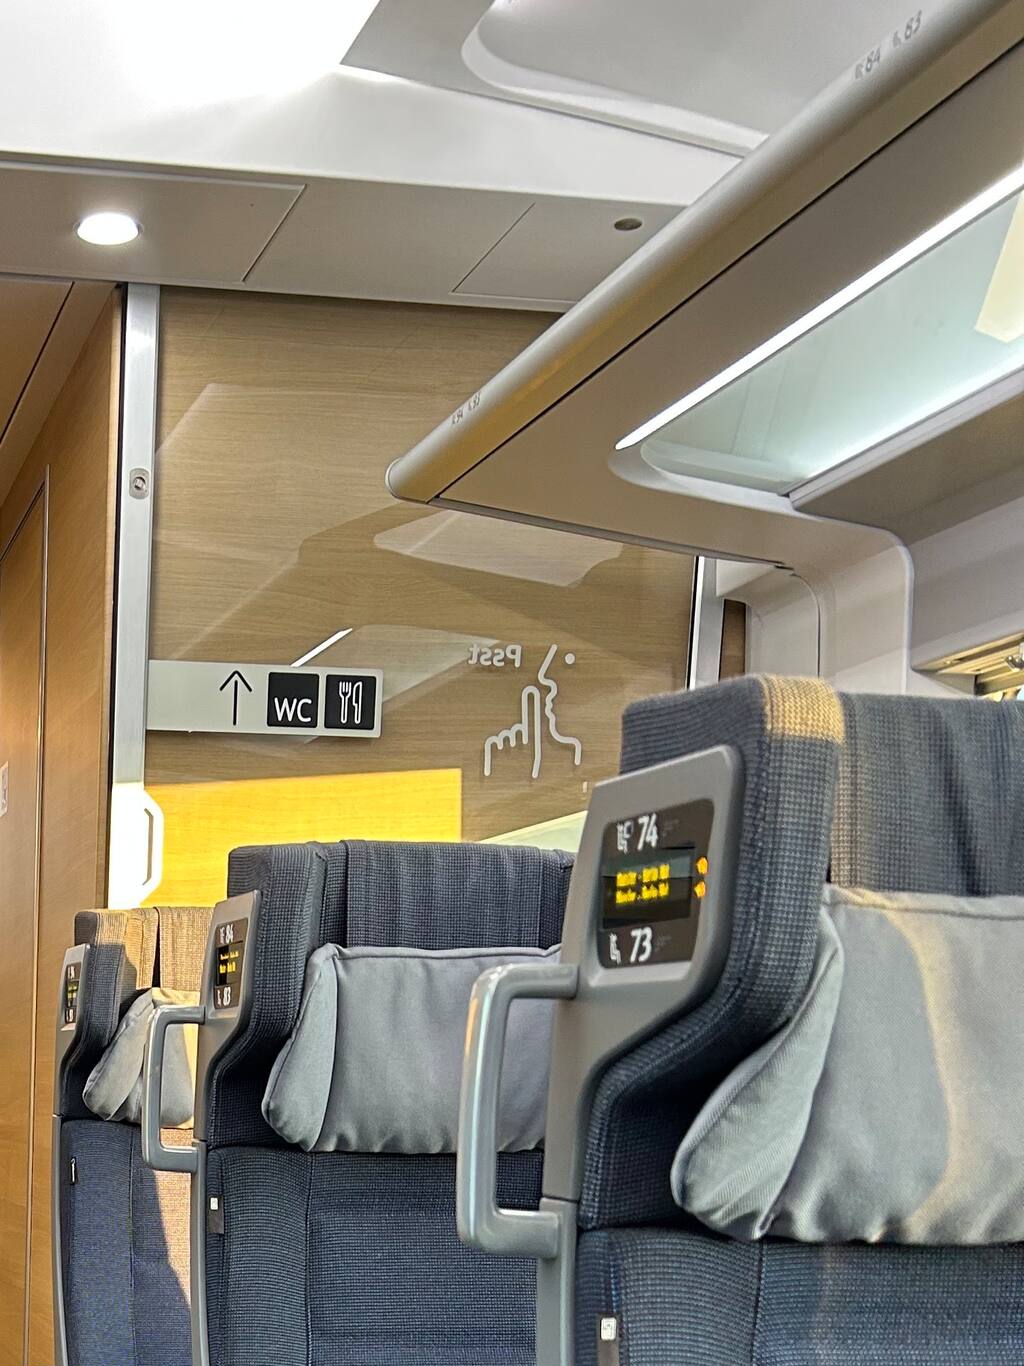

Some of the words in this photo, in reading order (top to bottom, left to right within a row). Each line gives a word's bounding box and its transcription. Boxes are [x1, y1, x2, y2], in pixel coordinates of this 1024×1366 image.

[865, 47, 881, 72] 84
[904, 10, 922, 40] 83
[274, 697, 313, 722] WC
[636, 813, 659, 852] 74
[225, 924, 234, 945] 84
[629, 926, 653, 963] 73
[222, 986, 231, 1006] 83
